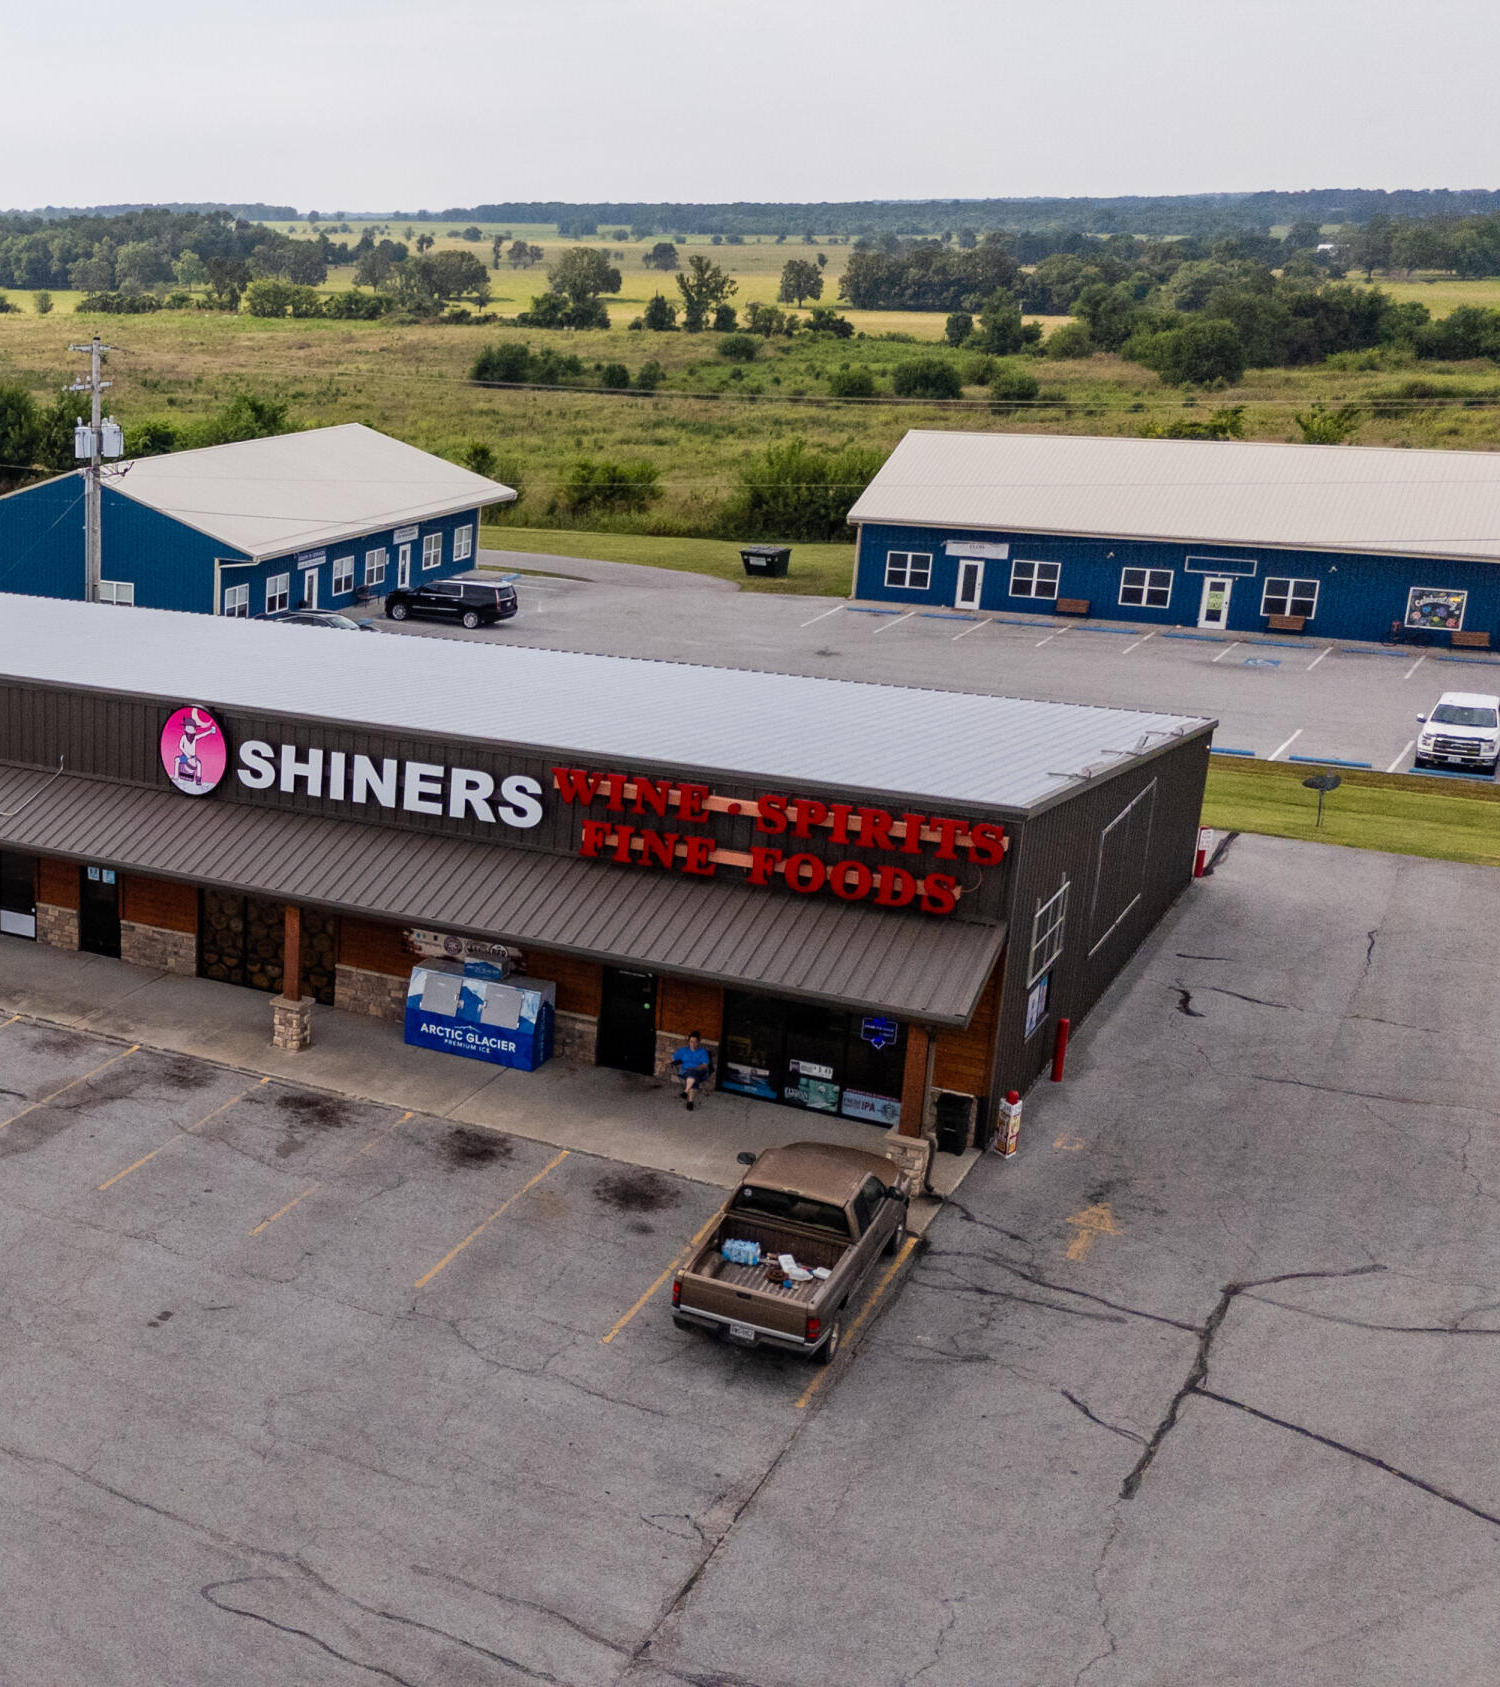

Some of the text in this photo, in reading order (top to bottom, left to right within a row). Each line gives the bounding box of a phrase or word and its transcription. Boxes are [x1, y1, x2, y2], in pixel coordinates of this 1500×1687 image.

[237, 740, 543, 829] SHINERS
[551, 767, 1006, 866] WINE SPIRITS
[578, 819, 957, 916] FINE FOODS
[420, 1023, 516, 1053] ARCTIC GLACIER
[444, 1039, 491, 1054] PREMIUM ICE
